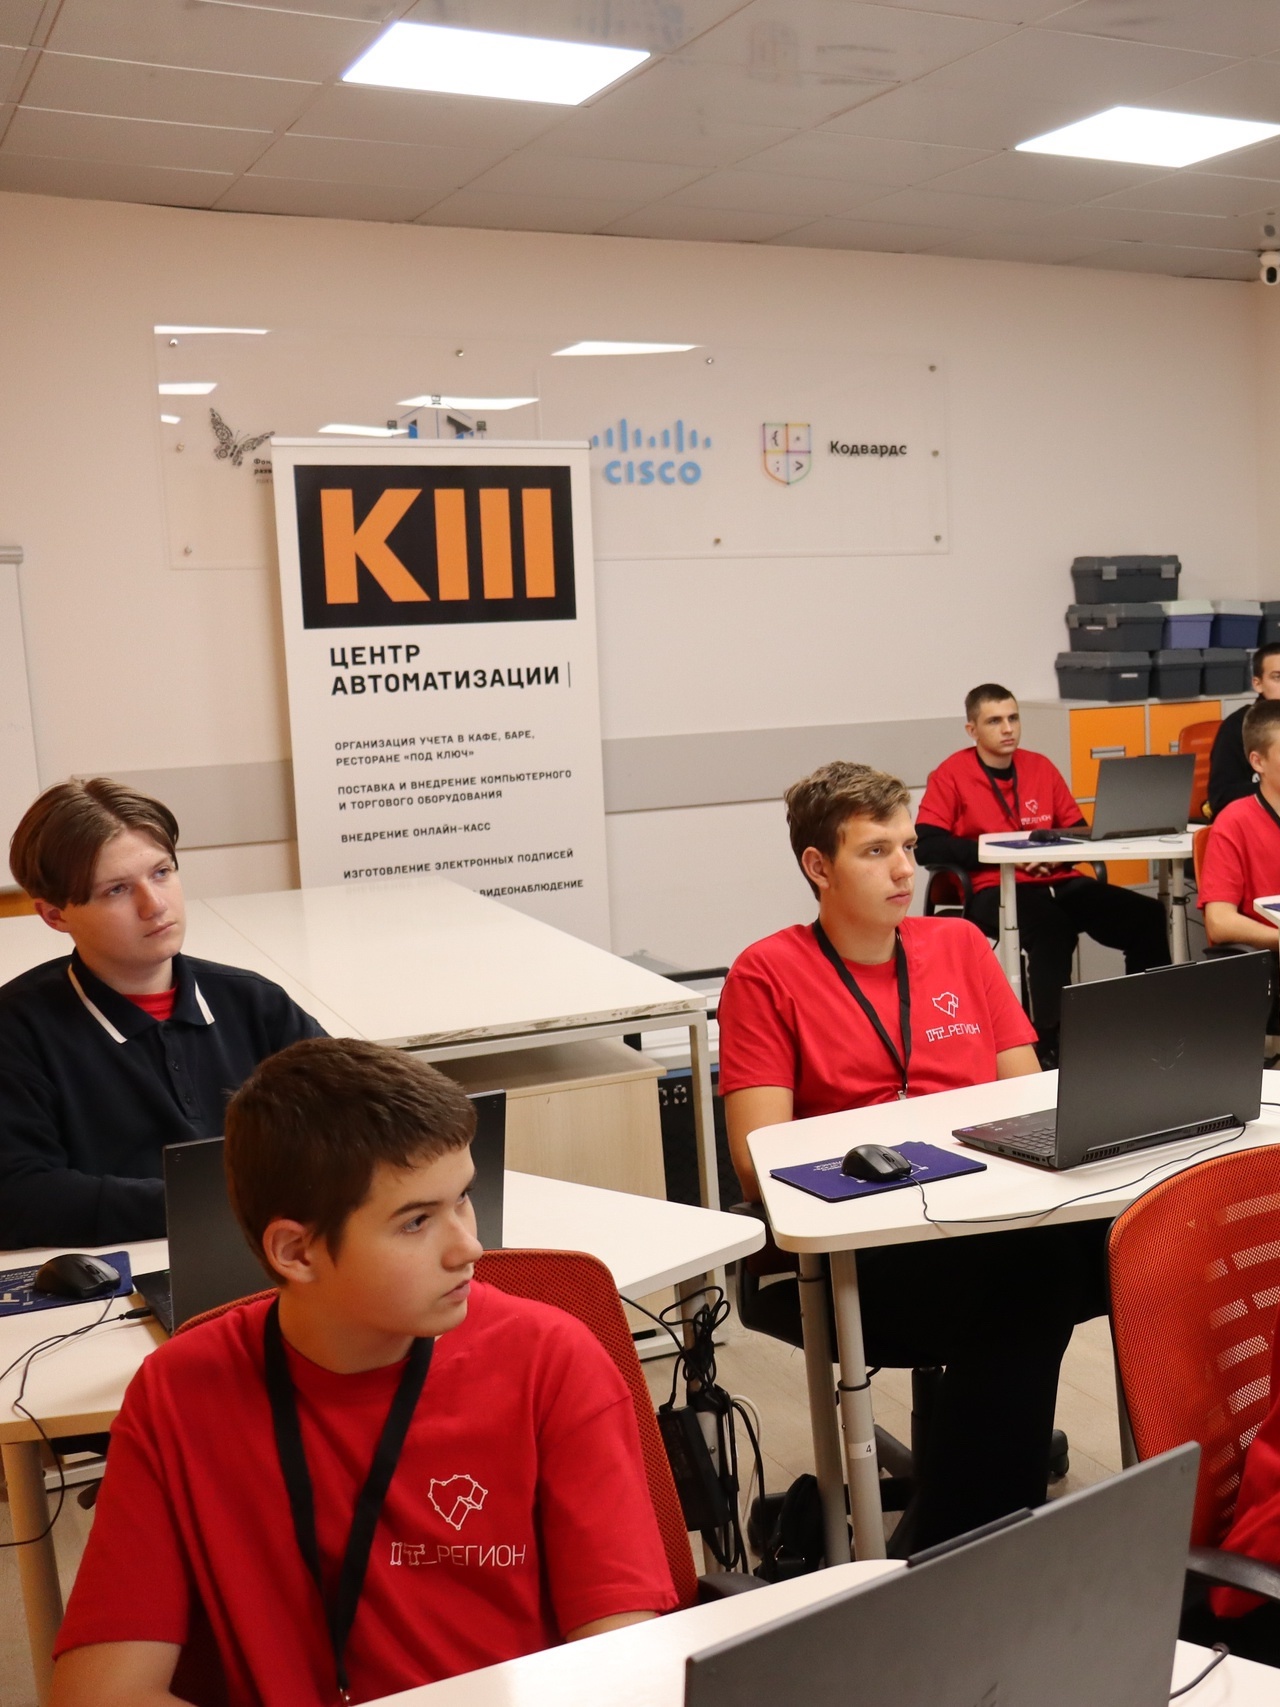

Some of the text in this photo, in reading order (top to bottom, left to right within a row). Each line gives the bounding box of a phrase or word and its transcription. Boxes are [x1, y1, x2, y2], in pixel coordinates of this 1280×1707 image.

[829, 440, 907, 457] Кодвардс
[605, 460, 702, 485] CISCO
[329, 643, 421, 670] ЦЕНТР
[331, 665, 560, 696] АВТОМАТИЗАЦИИ
[334, 729, 536, 751] ОРГАНИЗАЦИЯ УЧЕТА В КАФЕ, БАРЕ,
[335, 748, 475, 767] РЕСТОРАНЕ «ПОД КЛЮЧ»
[337, 769, 572, 795] ПОСТАВКА И ВНЕДРЕНИЕ КОМПЬЮТЕРНОГО
[338, 789, 503, 811] И ТОРГОВОГО ОБОРУДОВАНИЯ
[340, 821, 492, 844] ВНЕДРЕНИЕ ОНЛАЙН-КАСС
[343, 847, 574, 880] ИЗГОТОВЛЕНИЕ ЭЛЕКТРОННЫХ ПОДПИСЕЙ
[479, 879, 584, 898] ВИДЕОНАБЛЮДЕНИЕ
[865, 1444, 872, 1453] 4
